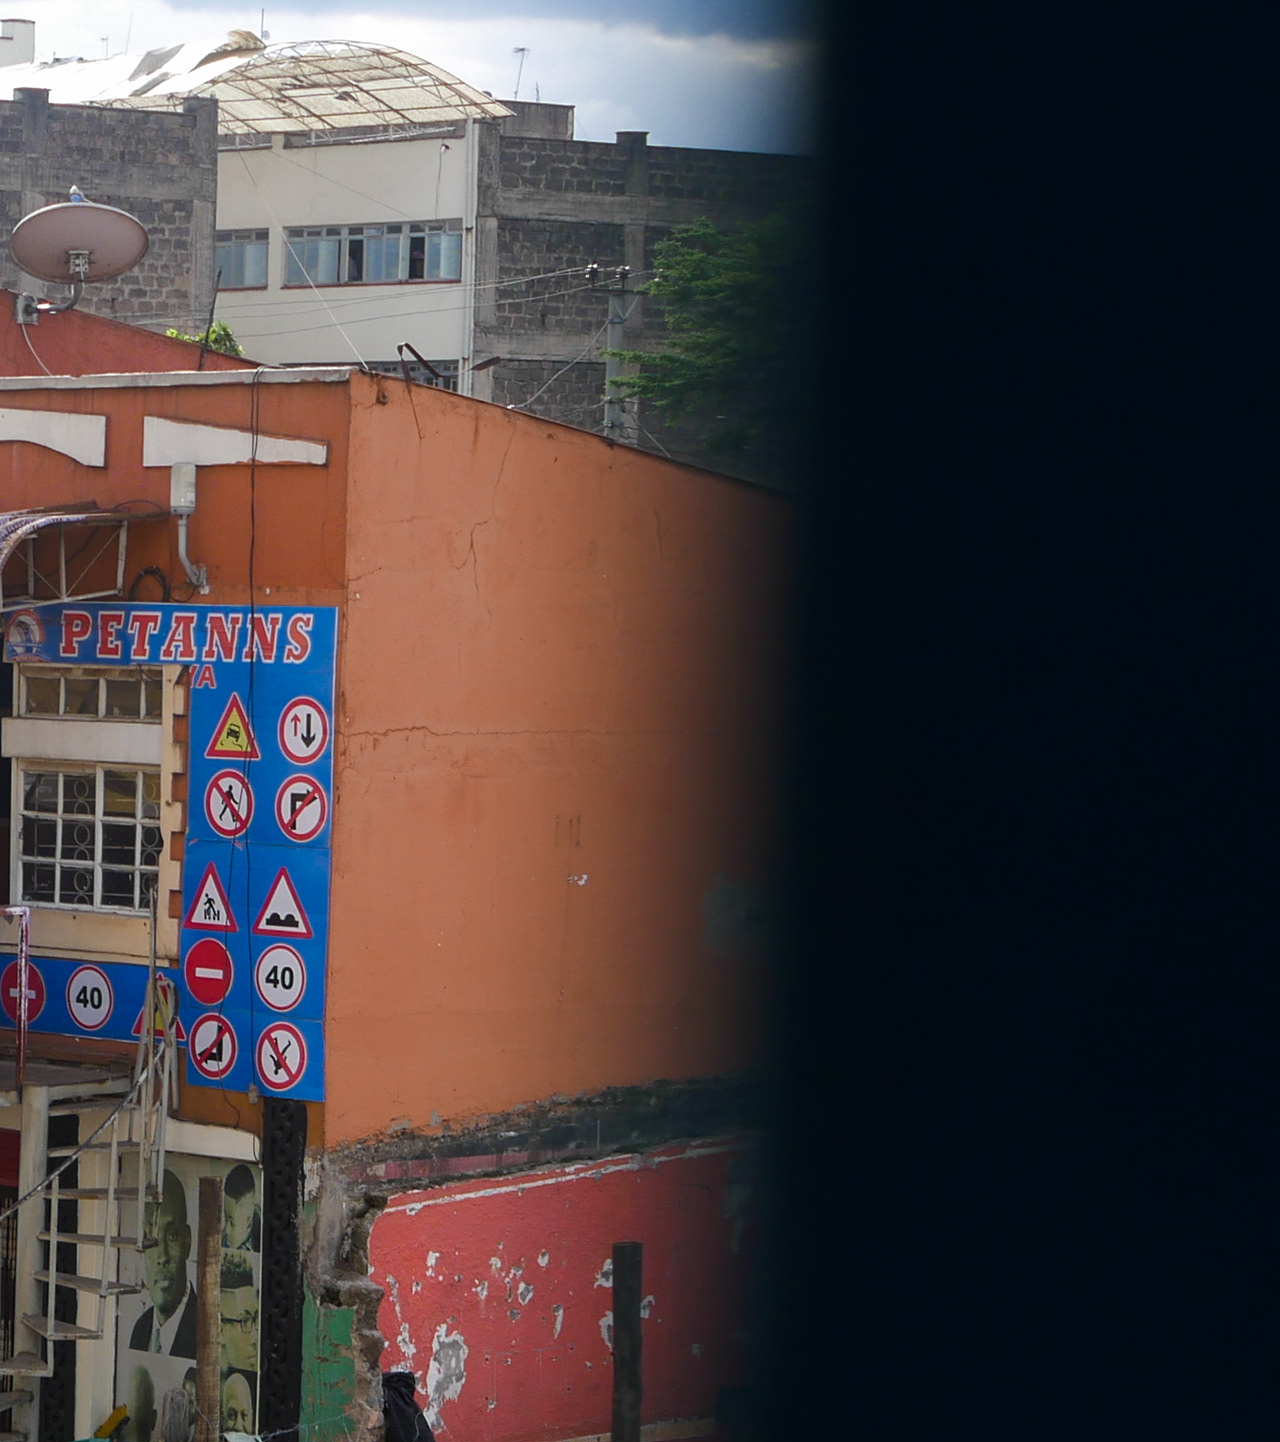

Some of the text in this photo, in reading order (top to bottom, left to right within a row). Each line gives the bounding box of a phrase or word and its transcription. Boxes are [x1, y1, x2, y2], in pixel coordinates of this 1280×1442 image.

[58, 609, 315, 664] PETANNS
[265, 964, 295, 991] 40
[75, 985, 103, 1012] 40
